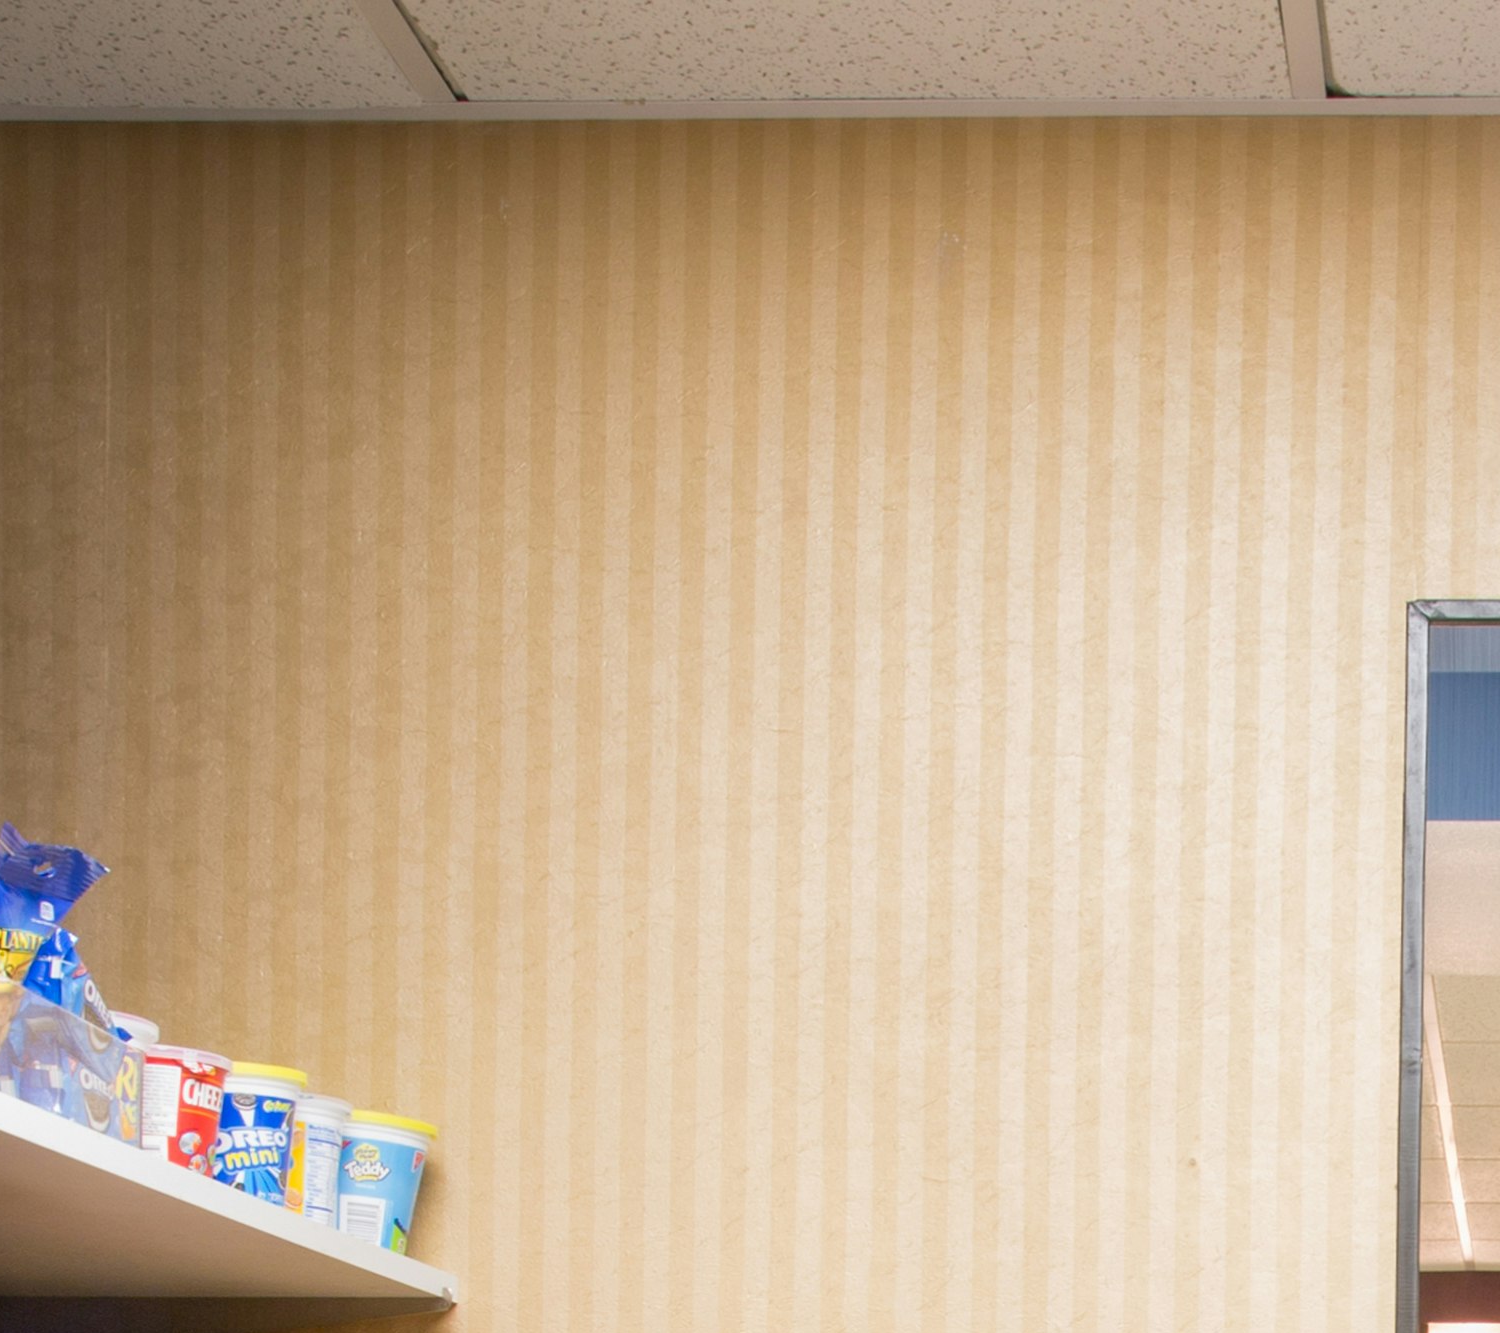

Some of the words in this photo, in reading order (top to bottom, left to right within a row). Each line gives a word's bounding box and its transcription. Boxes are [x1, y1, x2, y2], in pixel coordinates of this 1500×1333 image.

[214, 1129, 288, 1153] OREO
[226, 1149, 280, 1170] mini
[344, 1160, 391, 1181] Teddy
